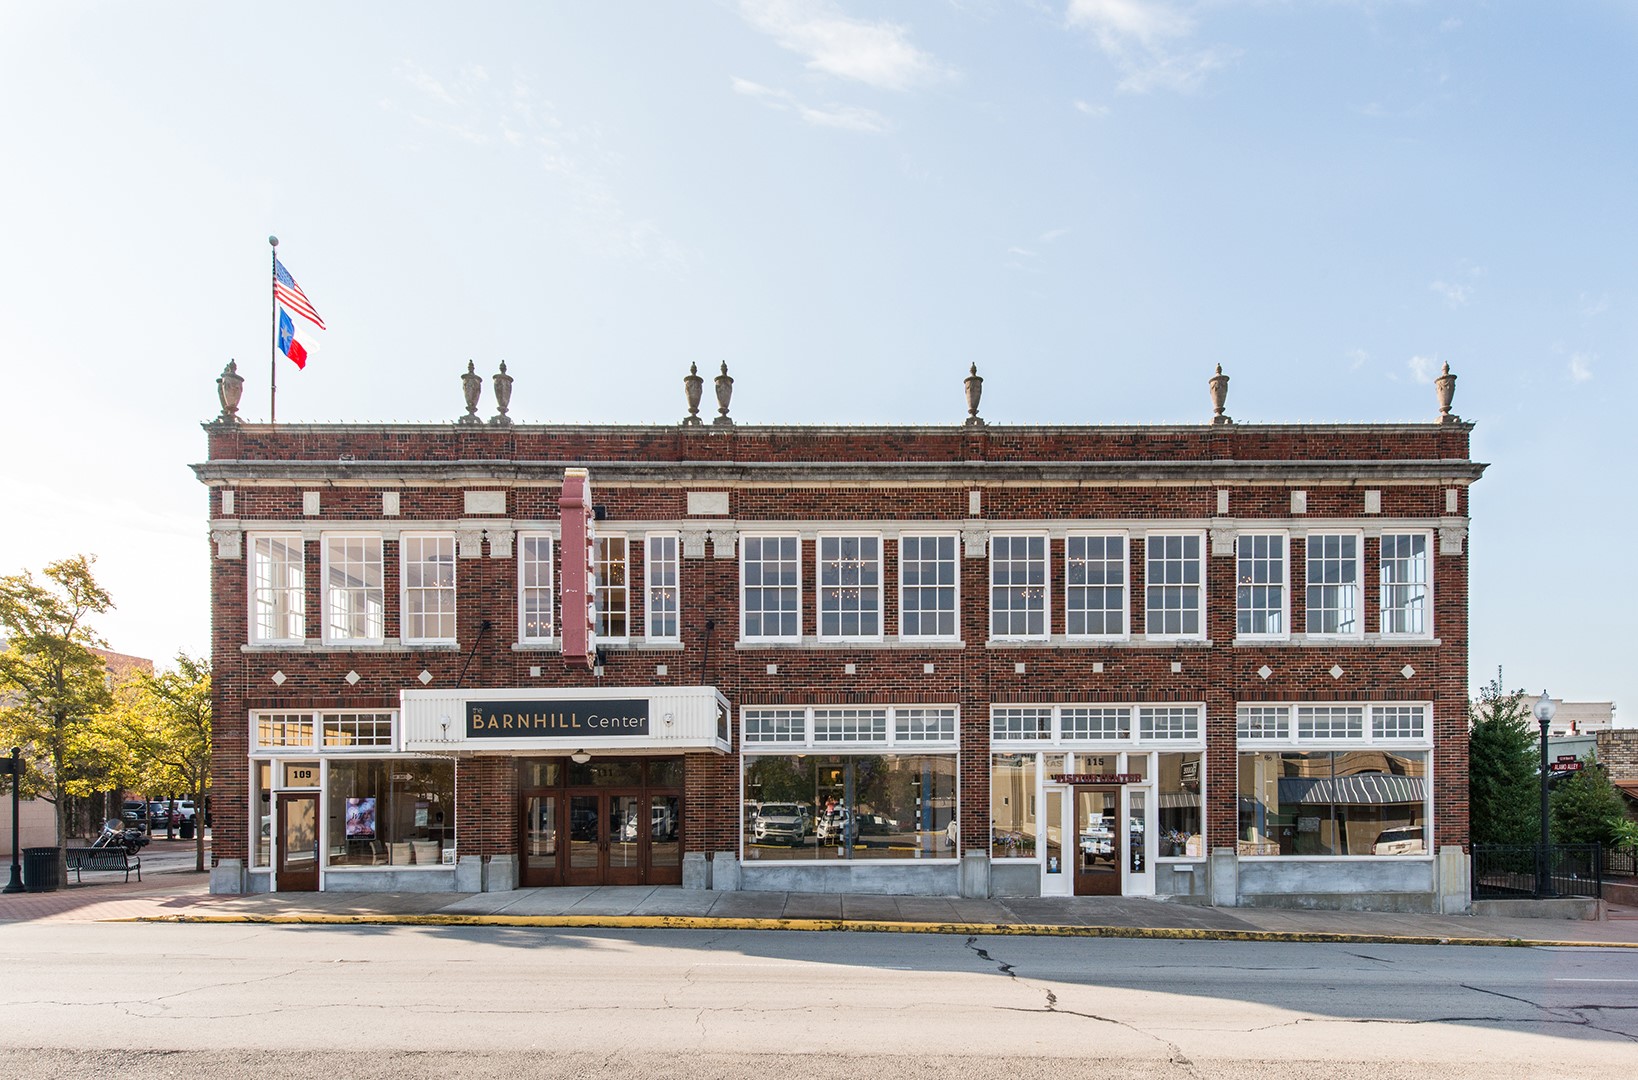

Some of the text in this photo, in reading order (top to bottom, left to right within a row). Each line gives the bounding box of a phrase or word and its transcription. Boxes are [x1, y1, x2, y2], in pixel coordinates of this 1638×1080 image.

[473, 713, 646, 729] BARNHILL Center
[1087, 757, 1104, 766] 115
[294, 770, 311, 779] 109
[1055, 774, 1142, 784] VISITOR CENTER
